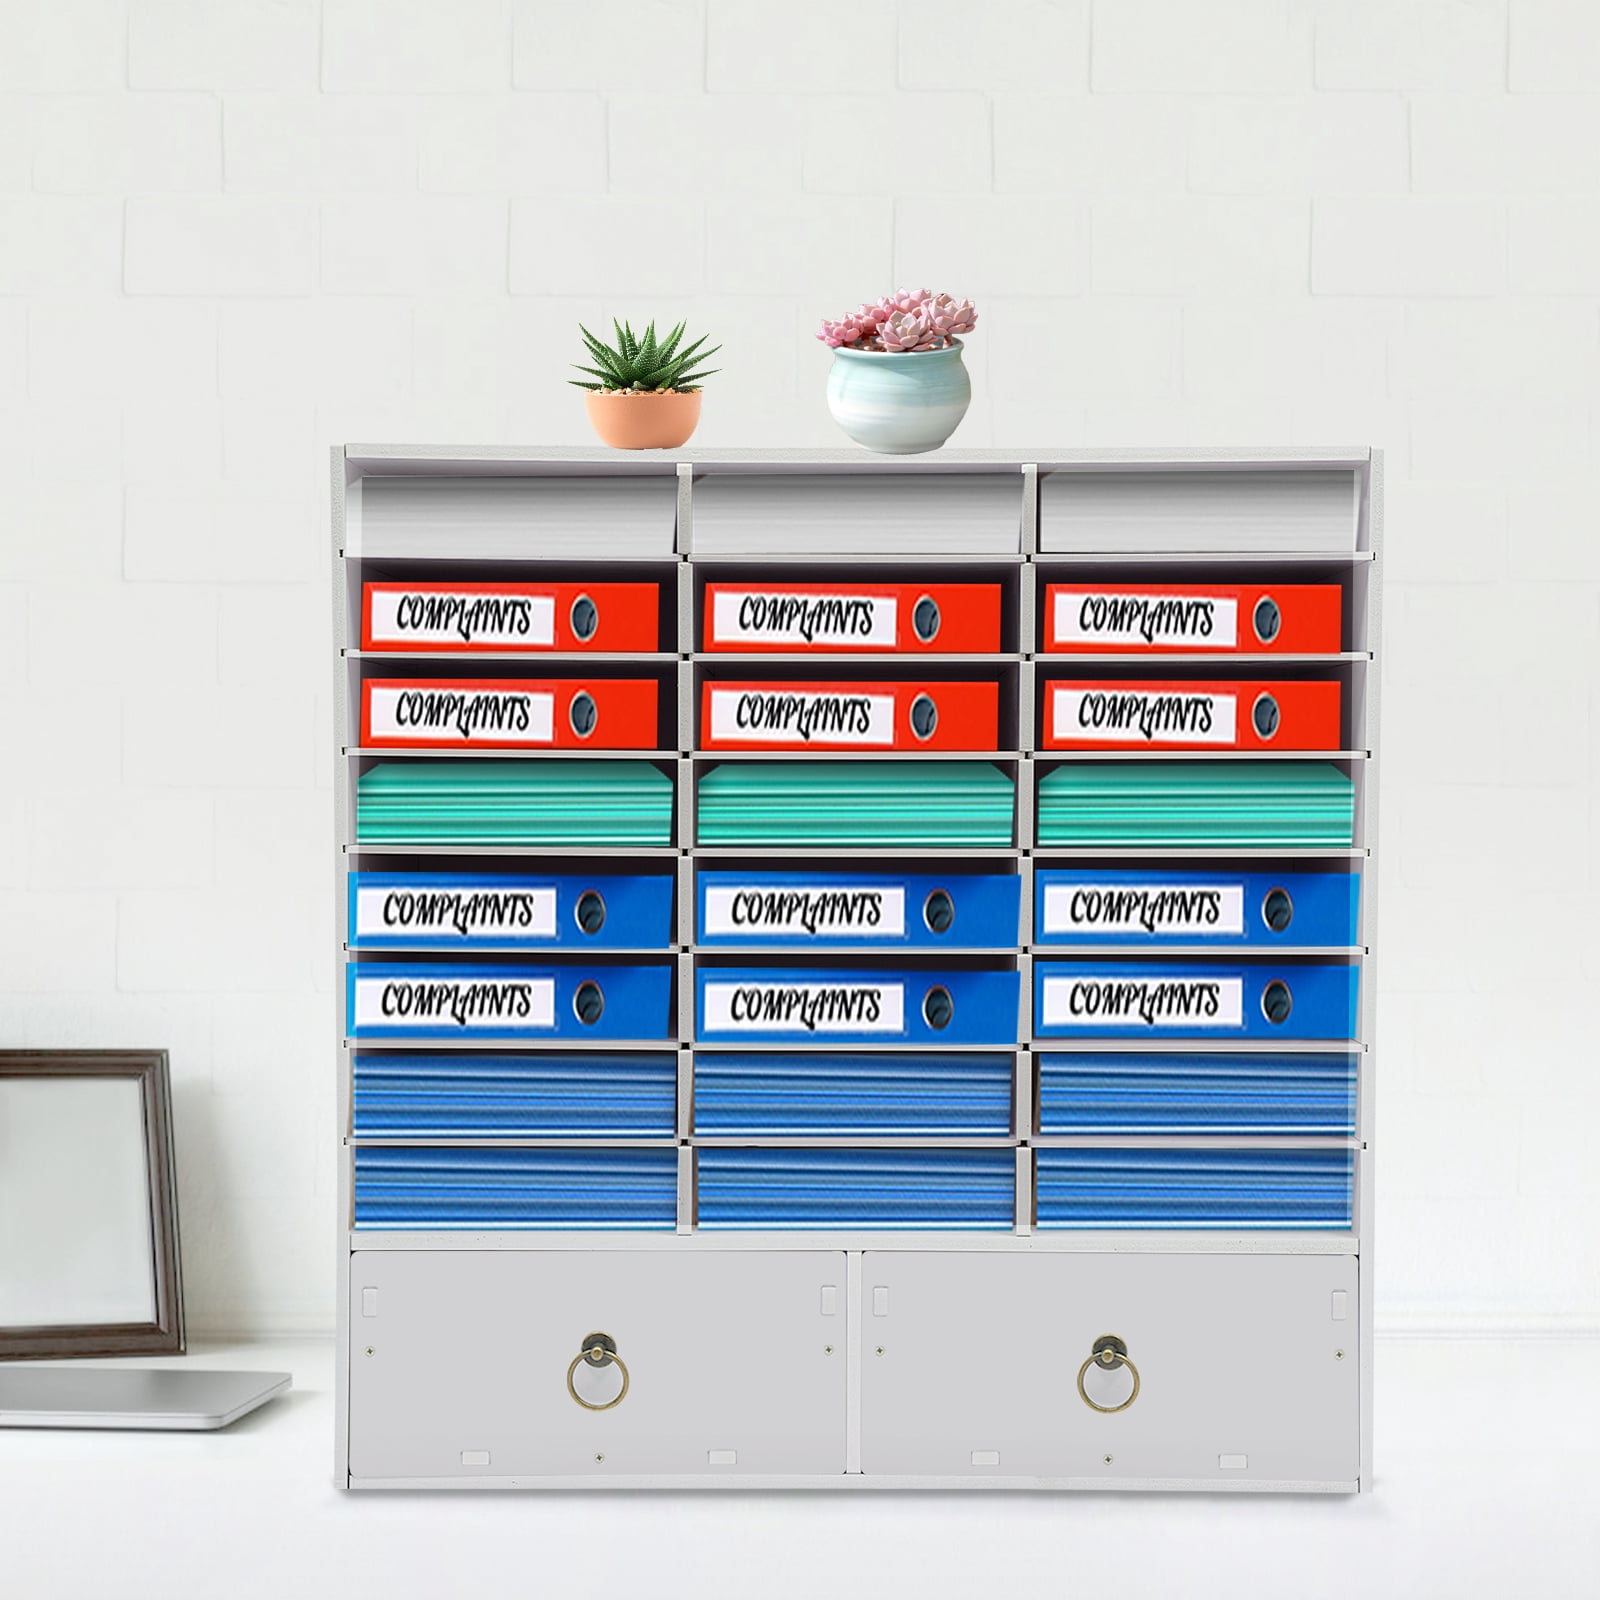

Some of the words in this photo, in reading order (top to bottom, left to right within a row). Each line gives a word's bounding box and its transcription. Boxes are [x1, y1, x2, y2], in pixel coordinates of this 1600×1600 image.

[396, 595, 532, 643] COMPLAINTS
[738, 596, 874, 644] COMPLAINTS
[1079, 597, 1215, 644] COMPLAINTS
[395, 691, 531, 739] COMPLAINTS
[736, 693, 871, 741] COMPLAINTS
[1078, 693, 1214, 740] COMPLAINTS
[383, 893, 534, 936] COMPLAINTS
[731, 892, 882, 935] COMPLAINTS
[1070, 891, 1221, 933] COMPLAINTS
[381, 984, 532, 1026] COMPLAINTS
[730, 989, 882, 1031] COMPLAINTS
[1069, 983, 1220, 1025] COMPLAINTS
